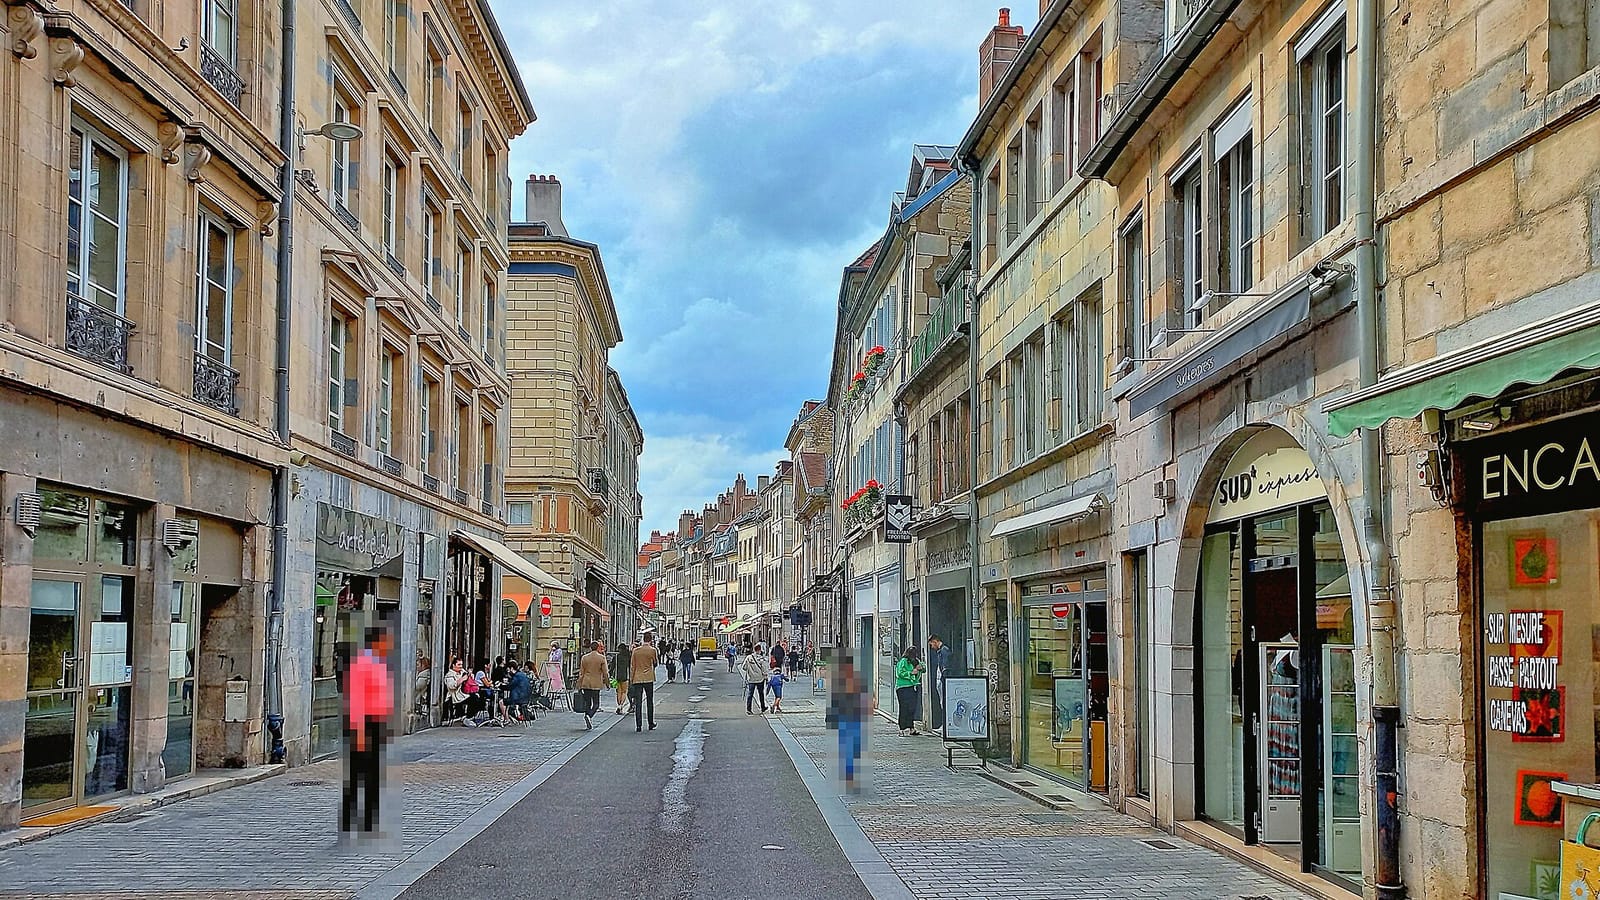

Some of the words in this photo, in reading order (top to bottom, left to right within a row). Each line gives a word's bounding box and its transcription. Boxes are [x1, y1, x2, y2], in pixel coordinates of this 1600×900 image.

[1482, 437, 1600, 500] ENCA
[1488, 612, 1505, 644] SUR
[1509, 612, 1543, 645] MESURE
[1489, 656, 1514, 689] PASSE
[1518, 656, 1558, 690] PARTOUT
[1489, 698, 1527, 734] CANEVAS
